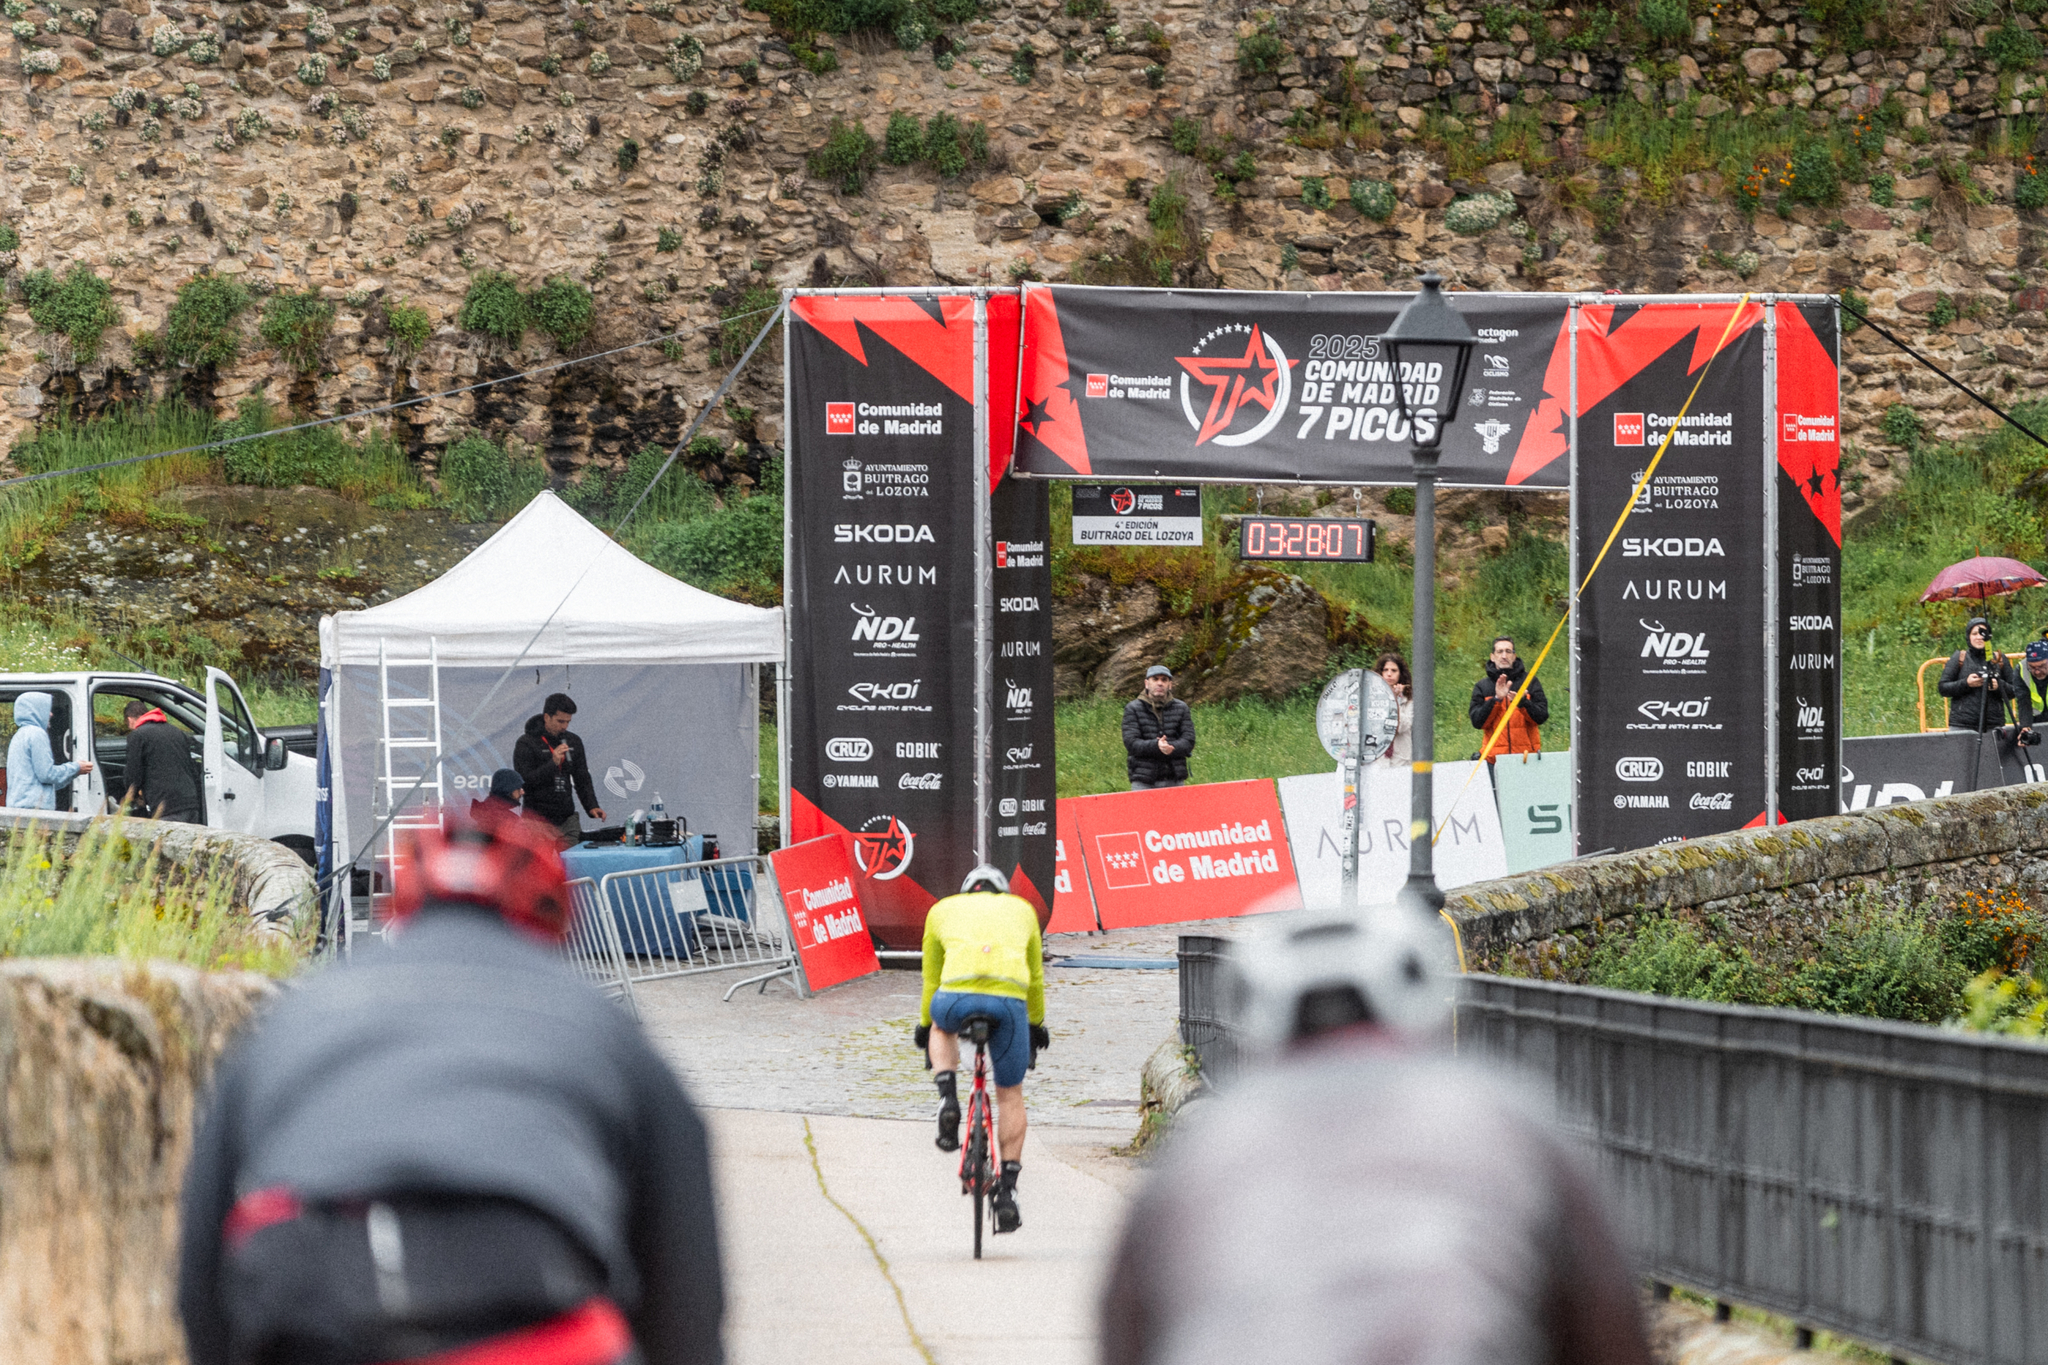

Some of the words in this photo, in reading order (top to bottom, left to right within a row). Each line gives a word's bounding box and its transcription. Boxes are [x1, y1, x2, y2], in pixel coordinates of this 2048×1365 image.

[1477, 327, 1519, 342] octagon
[1308, 334, 1380, 360] 2025
[1304, 360, 1443, 383] COMUNIDAD
[1109, 374, 1172, 387] Comunidad
[1109, 387, 1124, 400] de
[1127, 386, 1171, 400] Madrid
[1300, 382, 1336, 403] DE
[1340, 383, 1440, 405] MADRID
[858, 402, 942, 417] Comunidad
[858, 420, 879, 435] de
[884, 420, 942, 435] Madrid
[1296, 406, 1324, 439] 7
[1324, 406, 1438, 442] PICOS
[1647, 413, 1732, 428] Comunidad
[1797, 414, 1835, 427] Comunidad
[1647, 431, 1667, 446] de
[1673, 430, 1732, 446] Madrid
[1797, 428, 1807, 441] de
[1807, 428, 1835, 441] Madrid
[865, 464, 929, 472] AYUNTAMIENTO
[864, 474, 929, 484] BUITRAGO
[1654, 476, 1718, 484] AYUNTAMIENTO
[876, 486, 929, 496] LOZOYA
[1653, 486, 1719, 496] BUITRAGO
[1665, 498, 1719, 509] LOZOYA
[1125, 518, 1158, 529] EDICIÓN
[1080, 530, 1132, 540] BUITRAGO
[1134, 530, 1153, 540] DEL
[1156, 531, 1194, 541] LOZOYA
[1248, 522, 1363, 556] 03:28:07
[1006, 541, 1043, 553] Comunidad
[1006, 555, 1016, 567] de
[1017, 554, 1043, 567] Madrid
[834, 565, 937, 585] AURUM
[1622, 580, 1726, 600] AURUM
[851, 616, 920, 641] NDL
[1000, 641, 1041, 657] AURUM
[1640, 632, 1710, 658] NDL
[1789, 654, 1834, 670] AURUM
[1006, 688, 1033, 709] NDL
[1797, 706, 1825, 727] NDL
[830, 741, 867, 758] CRUZ
[896, 742, 939, 759] GOBIK
[1620, 762, 1658, 777] CRUZ
[1686, 762, 1729, 777] GOBIK
[836, 775, 879, 788] YAMAHA
[1626, 795, 1670, 808] YAMAHA
[1144, 819, 1272, 852] Comunidad
[1152, 860, 1185, 885] de
[1191, 847, 1279, 881] Madrid
[803, 876, 850, 908] Comunidad
[812, 921, 829, 944] de
[824, 907, 862, 942] Madrid
